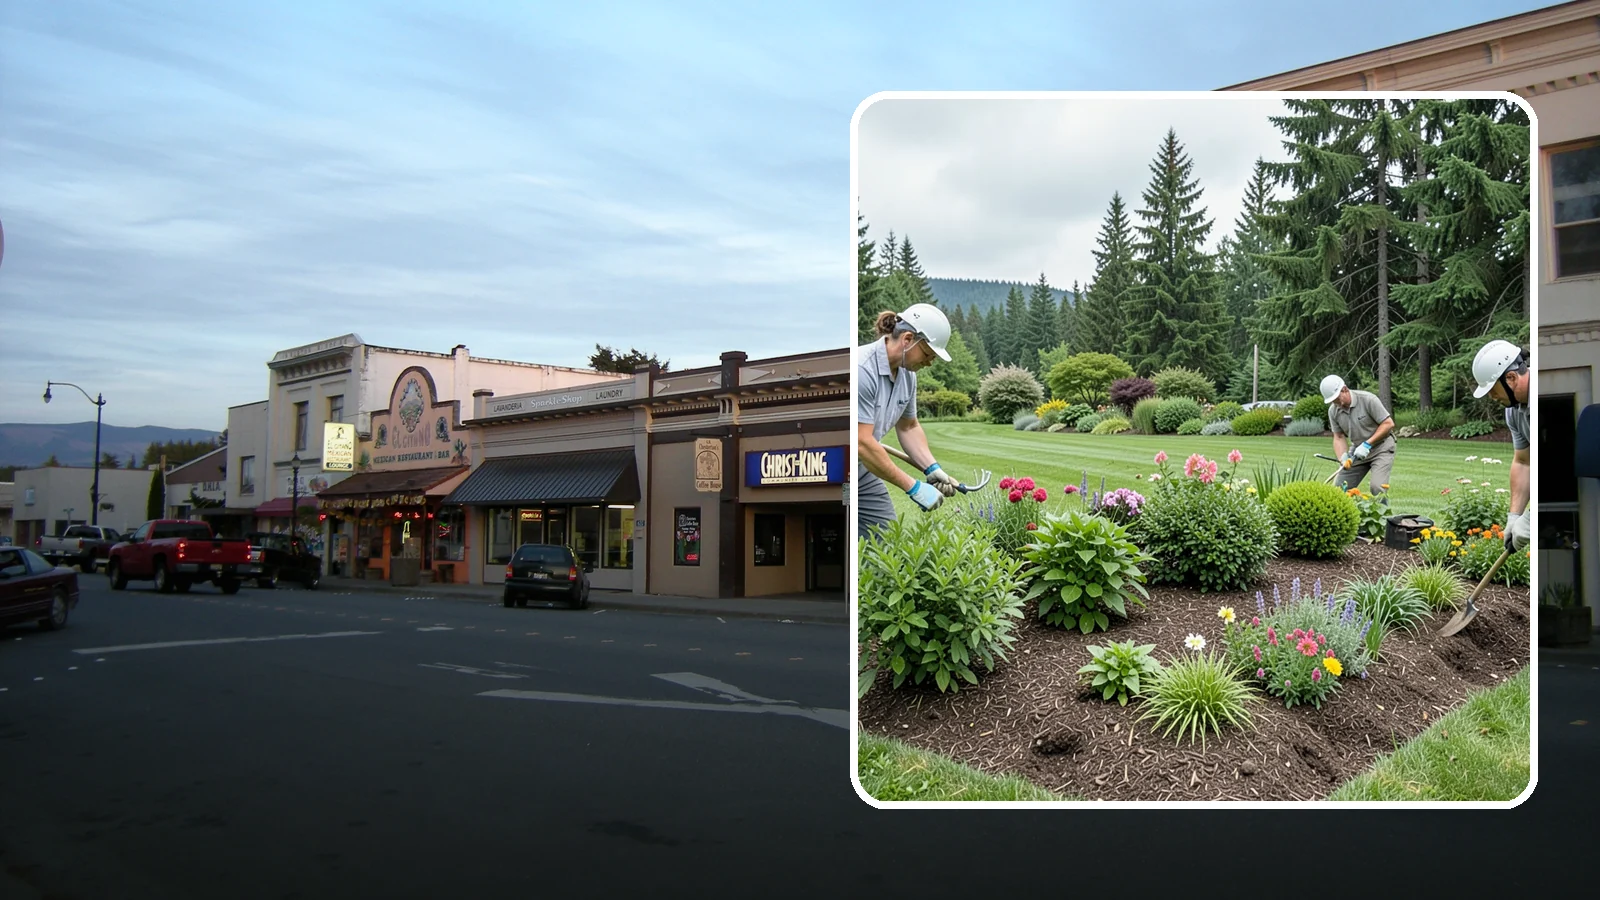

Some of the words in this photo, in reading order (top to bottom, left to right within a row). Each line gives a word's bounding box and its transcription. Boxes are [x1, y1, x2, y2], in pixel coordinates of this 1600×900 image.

[562, 394, 583, 405] Shop
[595, 389, 624, 400] LAUNDRY
[493, 402, 523, 413] LAVANDERIA
[373, 454, 396, 464] MEXICAN
[397, 452, 434, 462] RESTAURANT
[437, 450, 450, 459] BAR
[760, 452, 797, 478] CHRIST
[799, 450, 828, 477] KING
